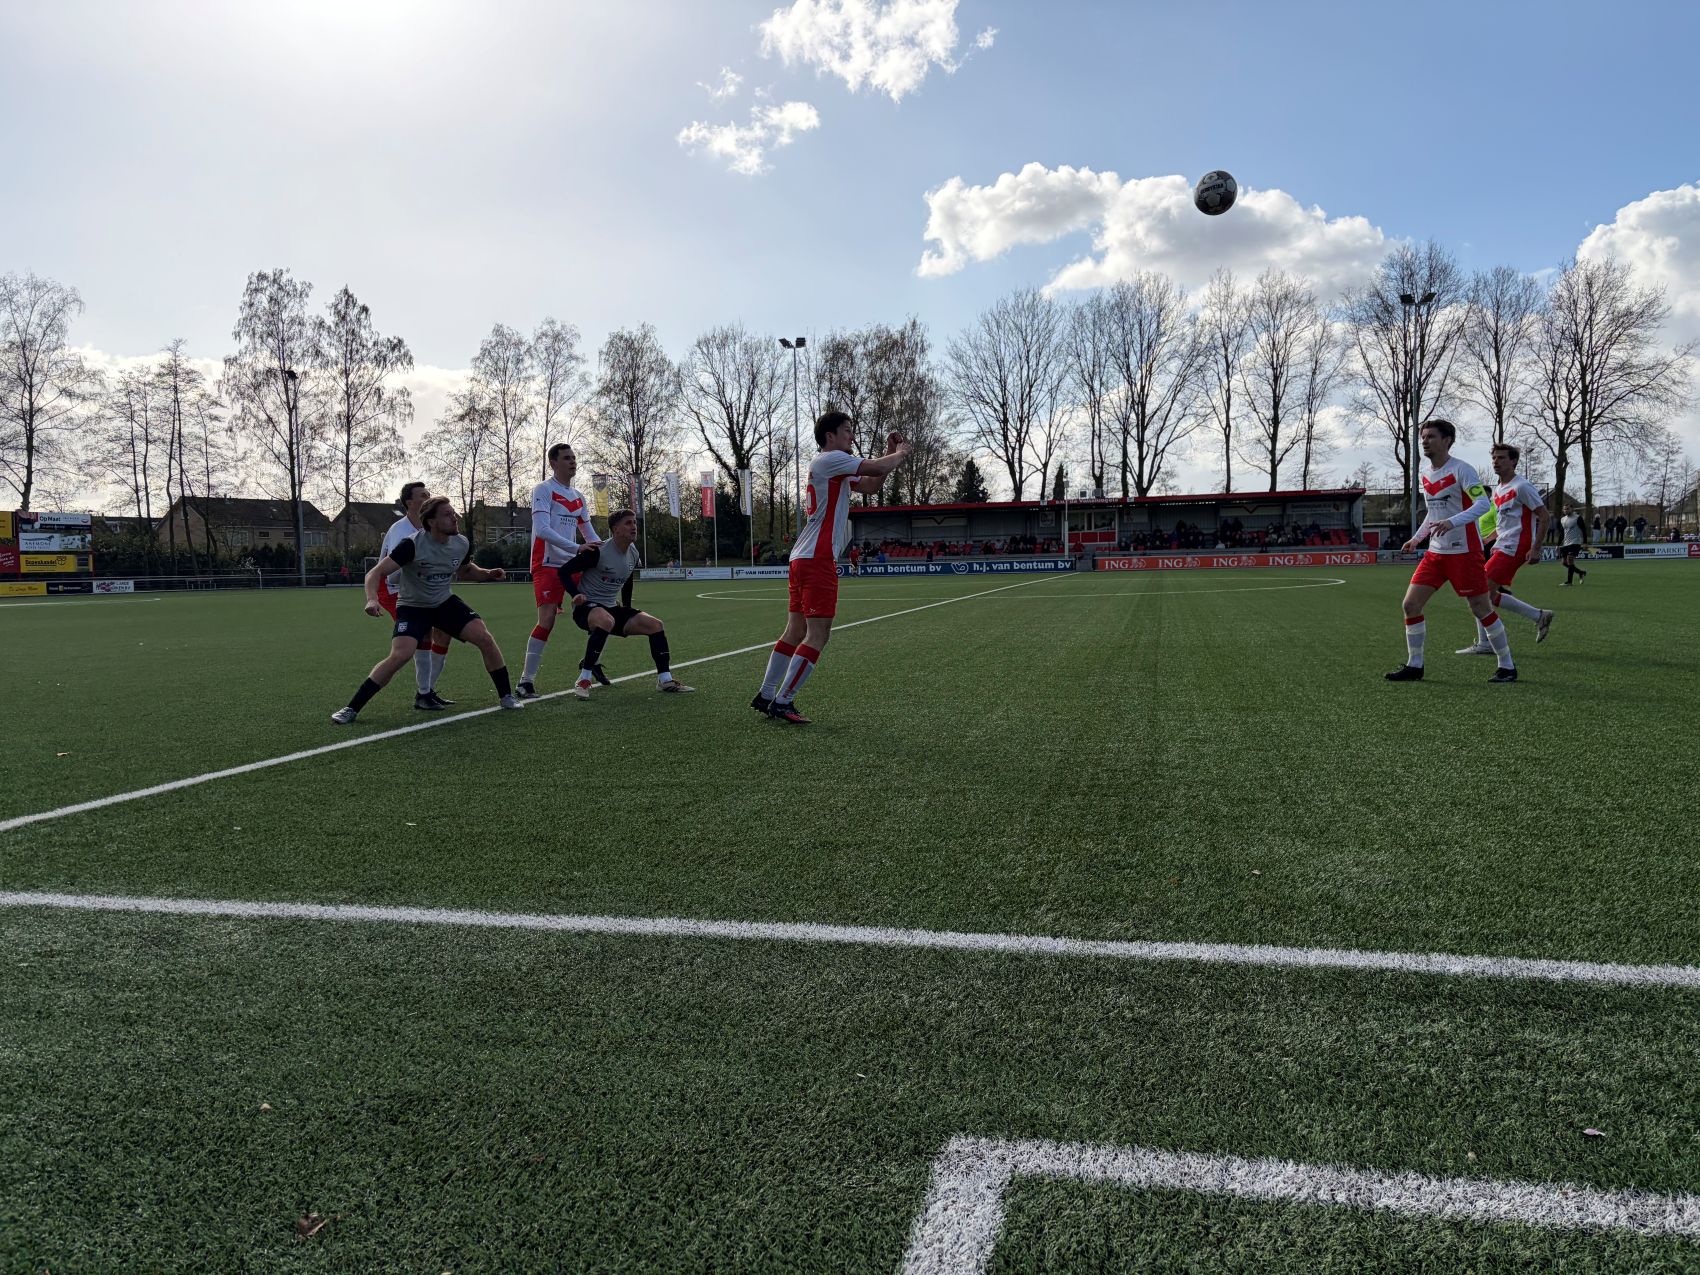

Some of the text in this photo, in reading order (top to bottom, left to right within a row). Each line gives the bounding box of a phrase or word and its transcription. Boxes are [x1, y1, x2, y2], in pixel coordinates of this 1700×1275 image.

[1468, 485, 1483, 497] C
[1104, 559, 1129, 569] ING
[1158, 558, 1183, 568] ING
[1212, 557, 1238, 566] ING
[1269, 556, 1294, 565] ING
[1325, 555, 1351, 564] ING
[887, 564, 926, 573] bentum
[929, 563, 942, 572] bv
[973, 562, 990, 572] h.j.
[1013, 561, 1054, 570] bentum
[1057, 560, 1071, 569] bv
